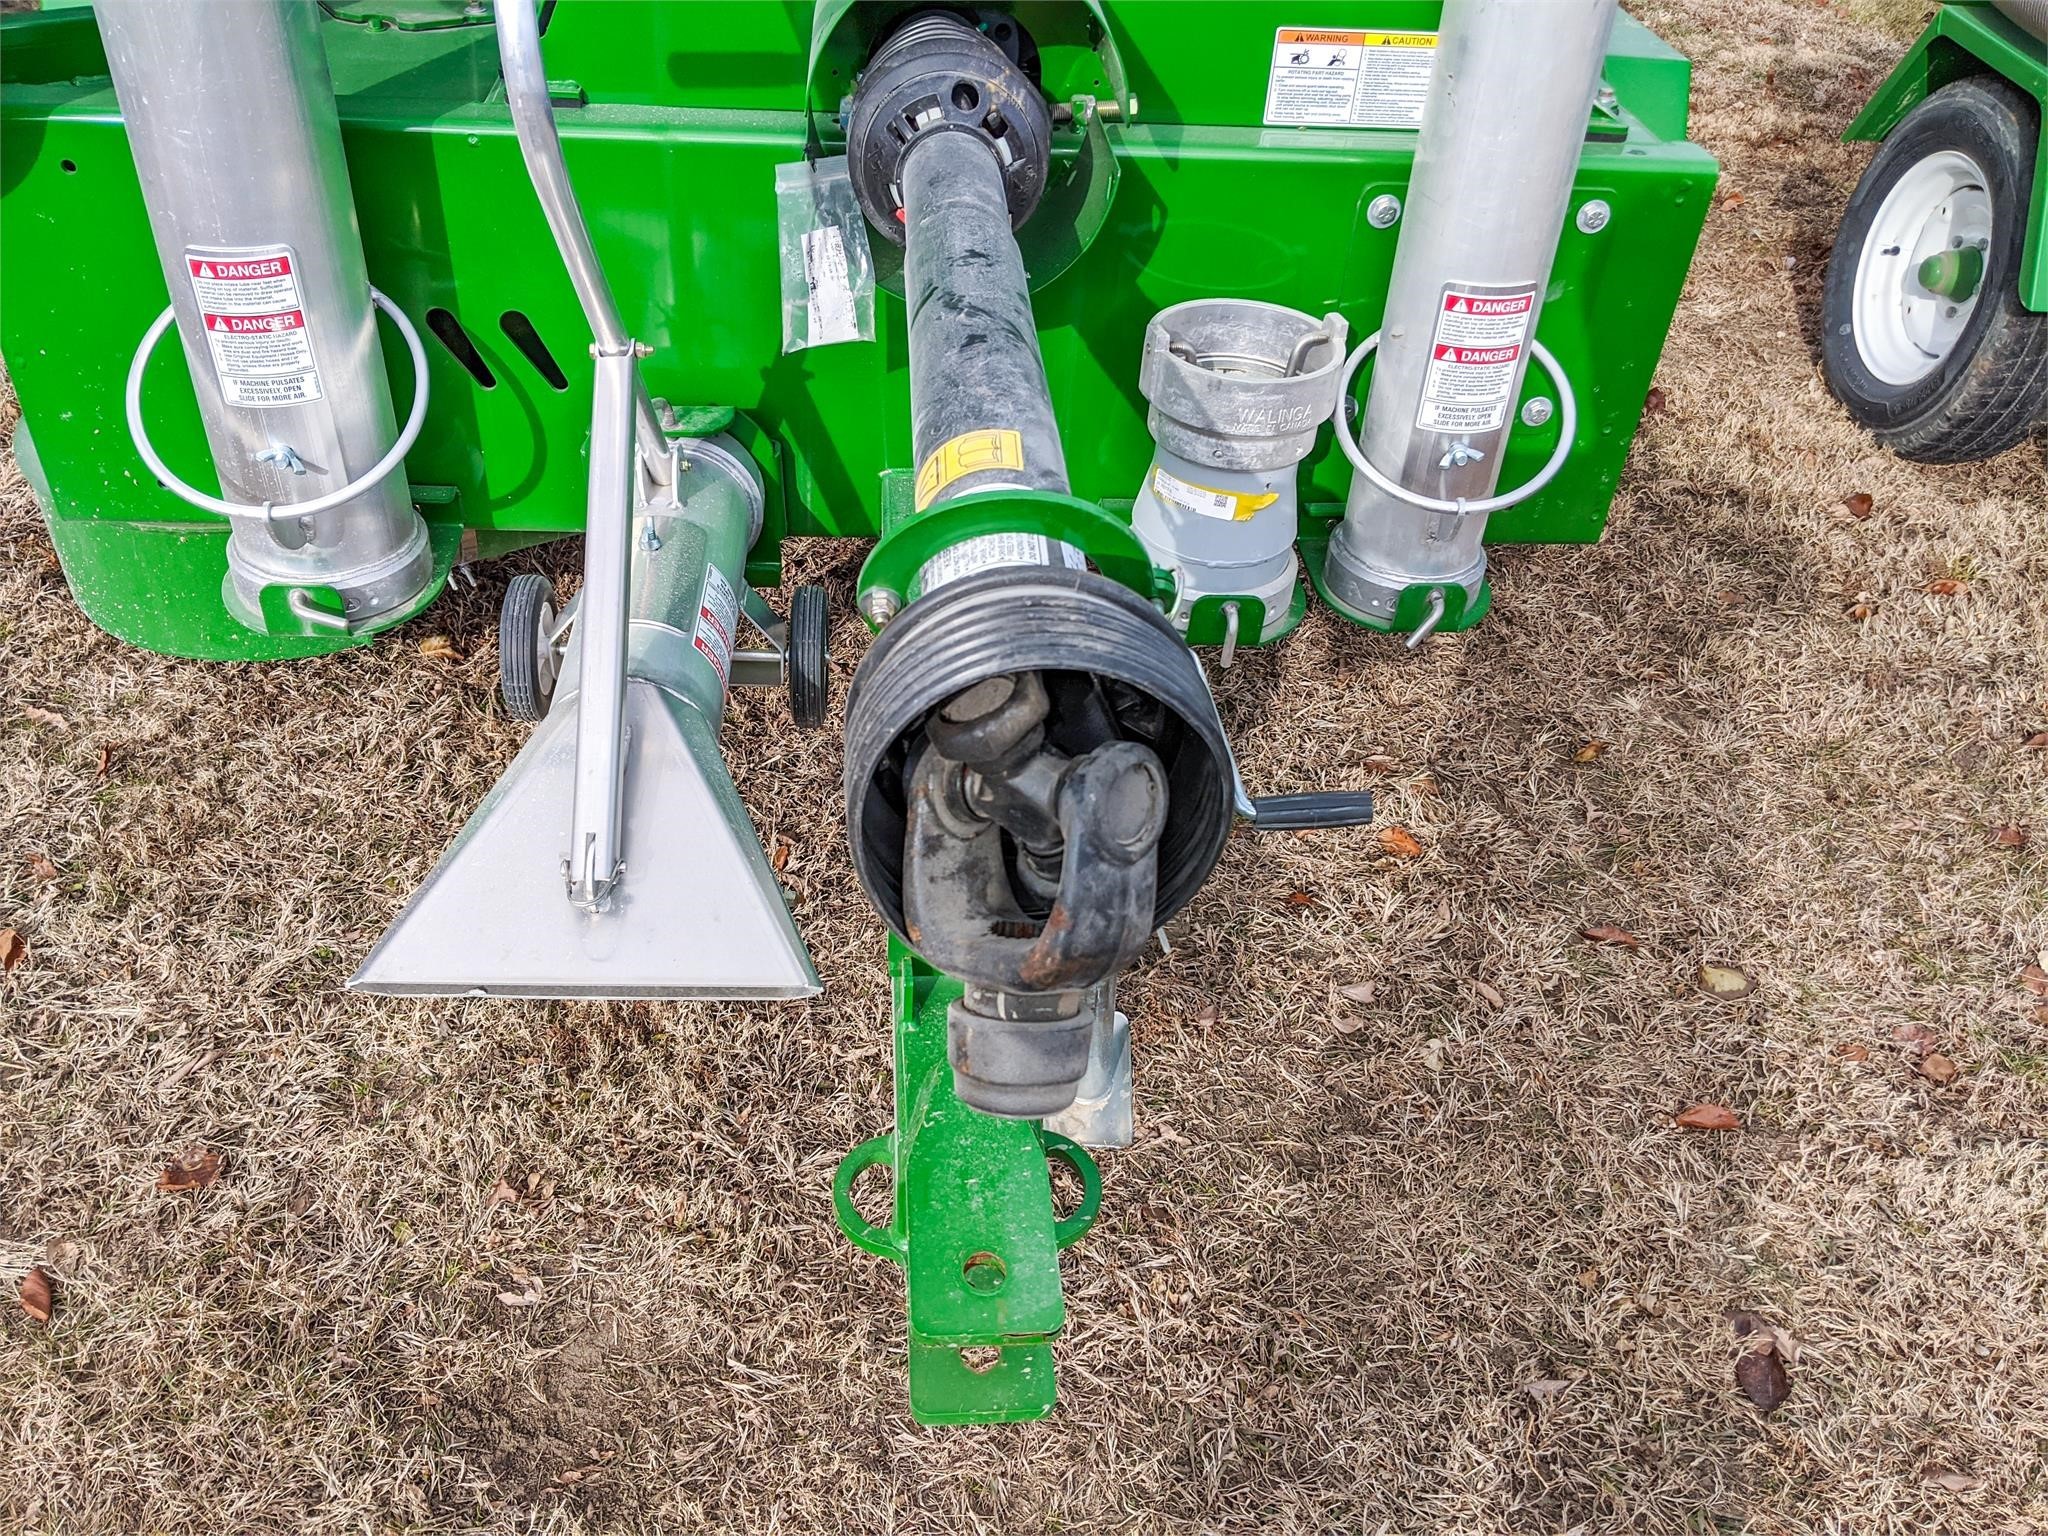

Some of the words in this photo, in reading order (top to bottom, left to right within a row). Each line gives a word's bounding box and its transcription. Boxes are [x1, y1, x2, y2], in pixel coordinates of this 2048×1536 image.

[1306, 34, 1349, 43] WARNING
[1392, 36, 1432, 46] CAUTION
[216, 262, 282, 277] DANGER
[1471, 301, 1526, 313] DANGER
[231, 315, 296, 331] DANGER
[1461, 349, 1514, 361] DANGER
[239, 379, 269, 387] MACHINE
[271, 376, 305, 386] PULSATES
[283, 385, 302, 394] OPEN
[238, 394, 256, 402] SLIDE
[272, 393, 292, 401] MORE
[1239, 404, 1312, 424] WALINGA
[1442, 405, 1469, 413] MACHINE
[1470, 405, 1497, 413] PULSATES
[1433, 419, 1450, 427] SLIDE
